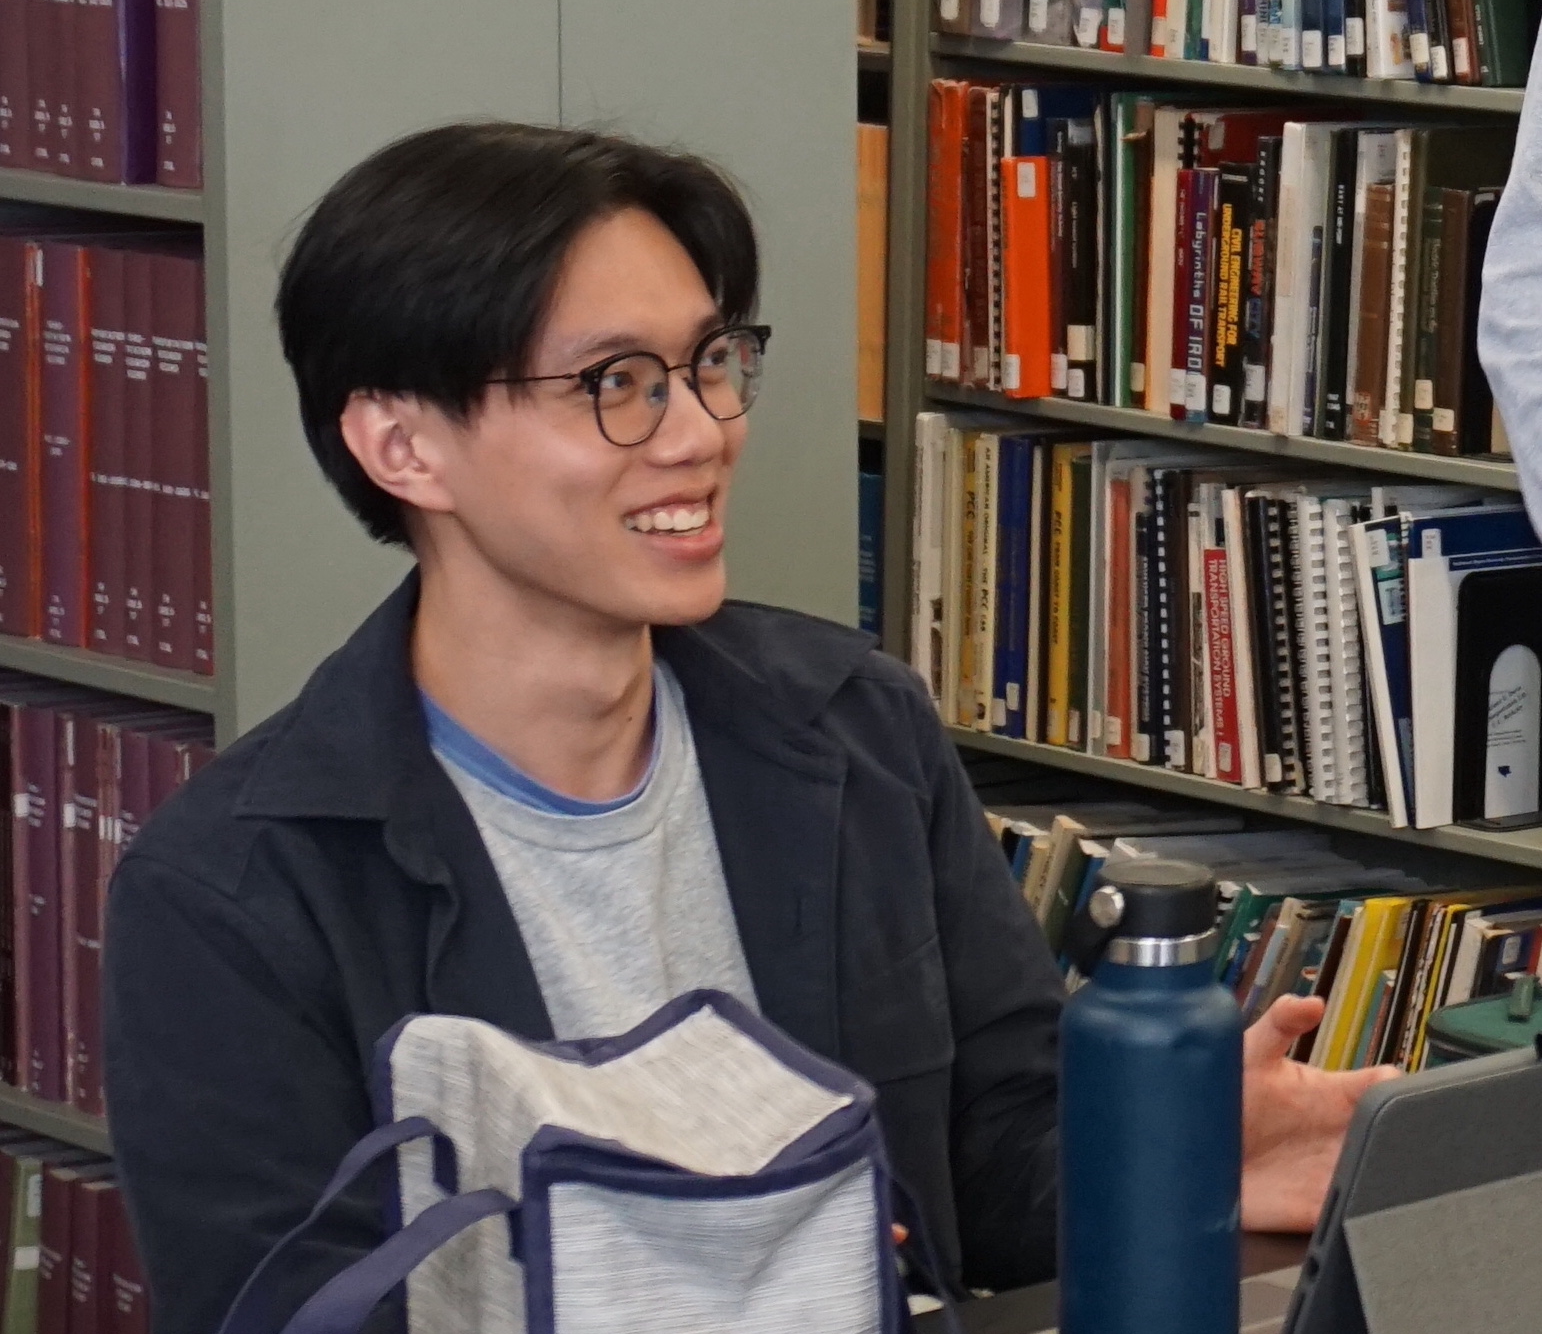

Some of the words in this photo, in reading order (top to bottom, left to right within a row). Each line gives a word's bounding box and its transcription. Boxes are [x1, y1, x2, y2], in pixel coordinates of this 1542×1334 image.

[1191, 211, 1207, 298] Labyrinths
[1219, 202, 1233, 280] UNDERGROUND
[1230, 227, 1243, 253] CIVIL
[1217, 281, 1229, 305] RAIL
[1227, 254, 1242, 323] ENGINEERING
[1189, 303, 1205, 330] OF
[1226, 323, 1238, 346] FOR
[1214, 306, 1228, 368] TRANSPORT
[966, 490, 976, 521] PCC
[1053, 510, 1063, 534] PCC
[1217, 558, 1228, 593] HIGH
[1207, 558, 1222, 671] TRANSPORTATION
[1219, 595, 1229, 635] SPEED
[1221, 637, 1232, 698] GROUND
[1213, 673, 1225, 729] SYSTEMS
